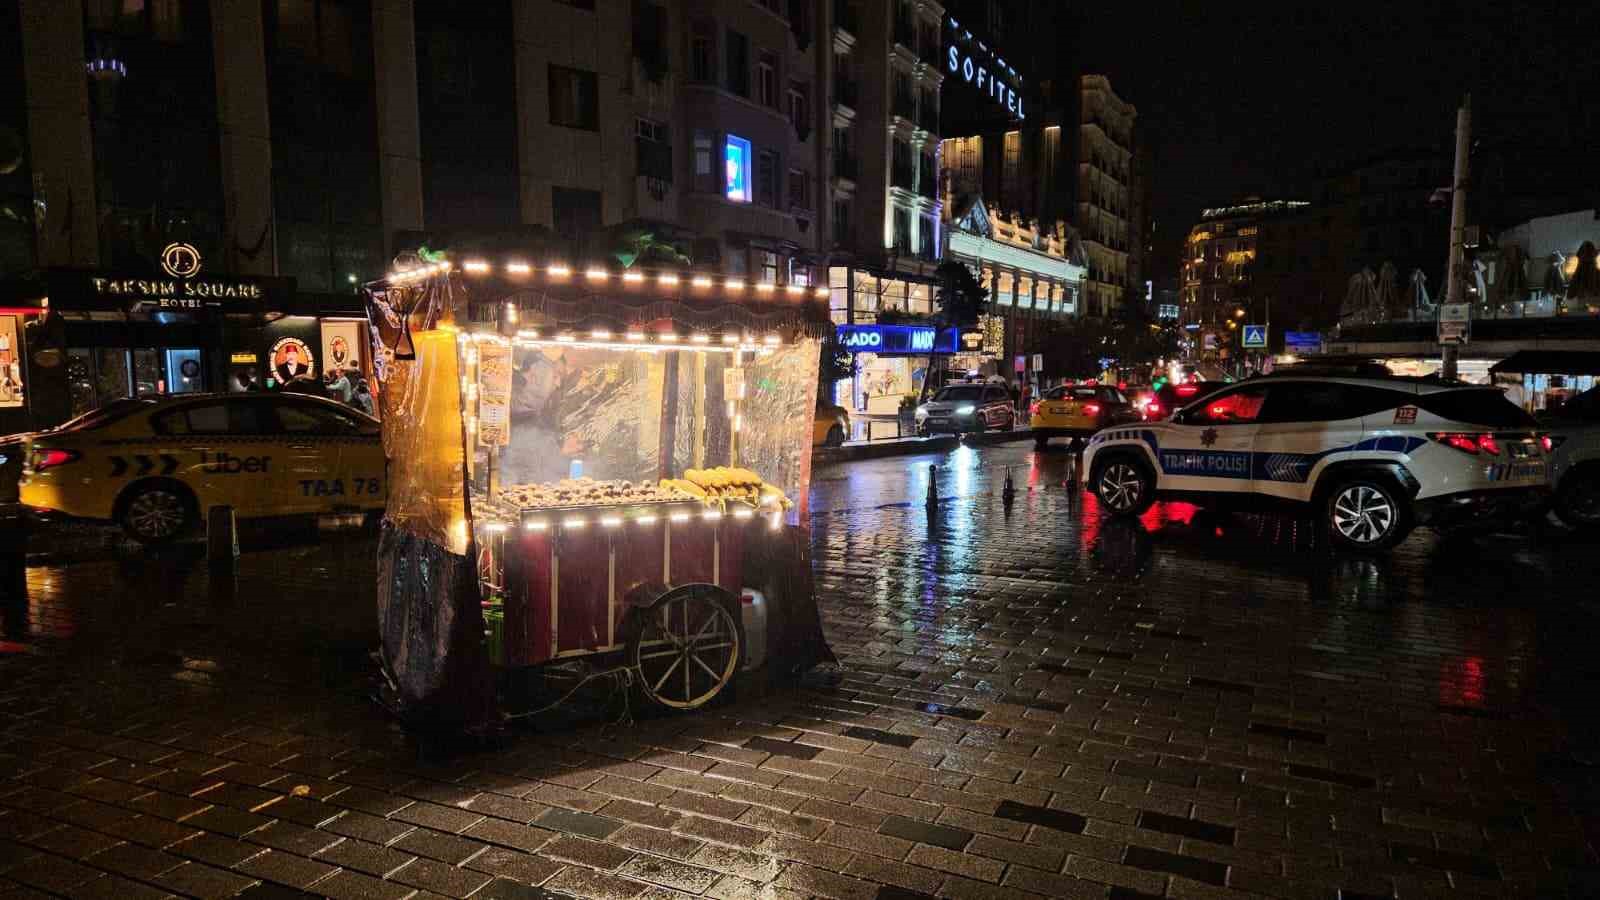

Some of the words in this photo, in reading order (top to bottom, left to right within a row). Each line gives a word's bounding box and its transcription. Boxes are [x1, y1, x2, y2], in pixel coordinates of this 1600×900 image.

[949, 45, 1025, 119] SOFITEL
[93, 277, 175, 295] TAKSIM
[185, 280, 264, 298] SQUARE
[159, 298, 201, 308] HOTEL
[200, 451, 272, 473] Uber
[299, 480, 345, 496] TAA
